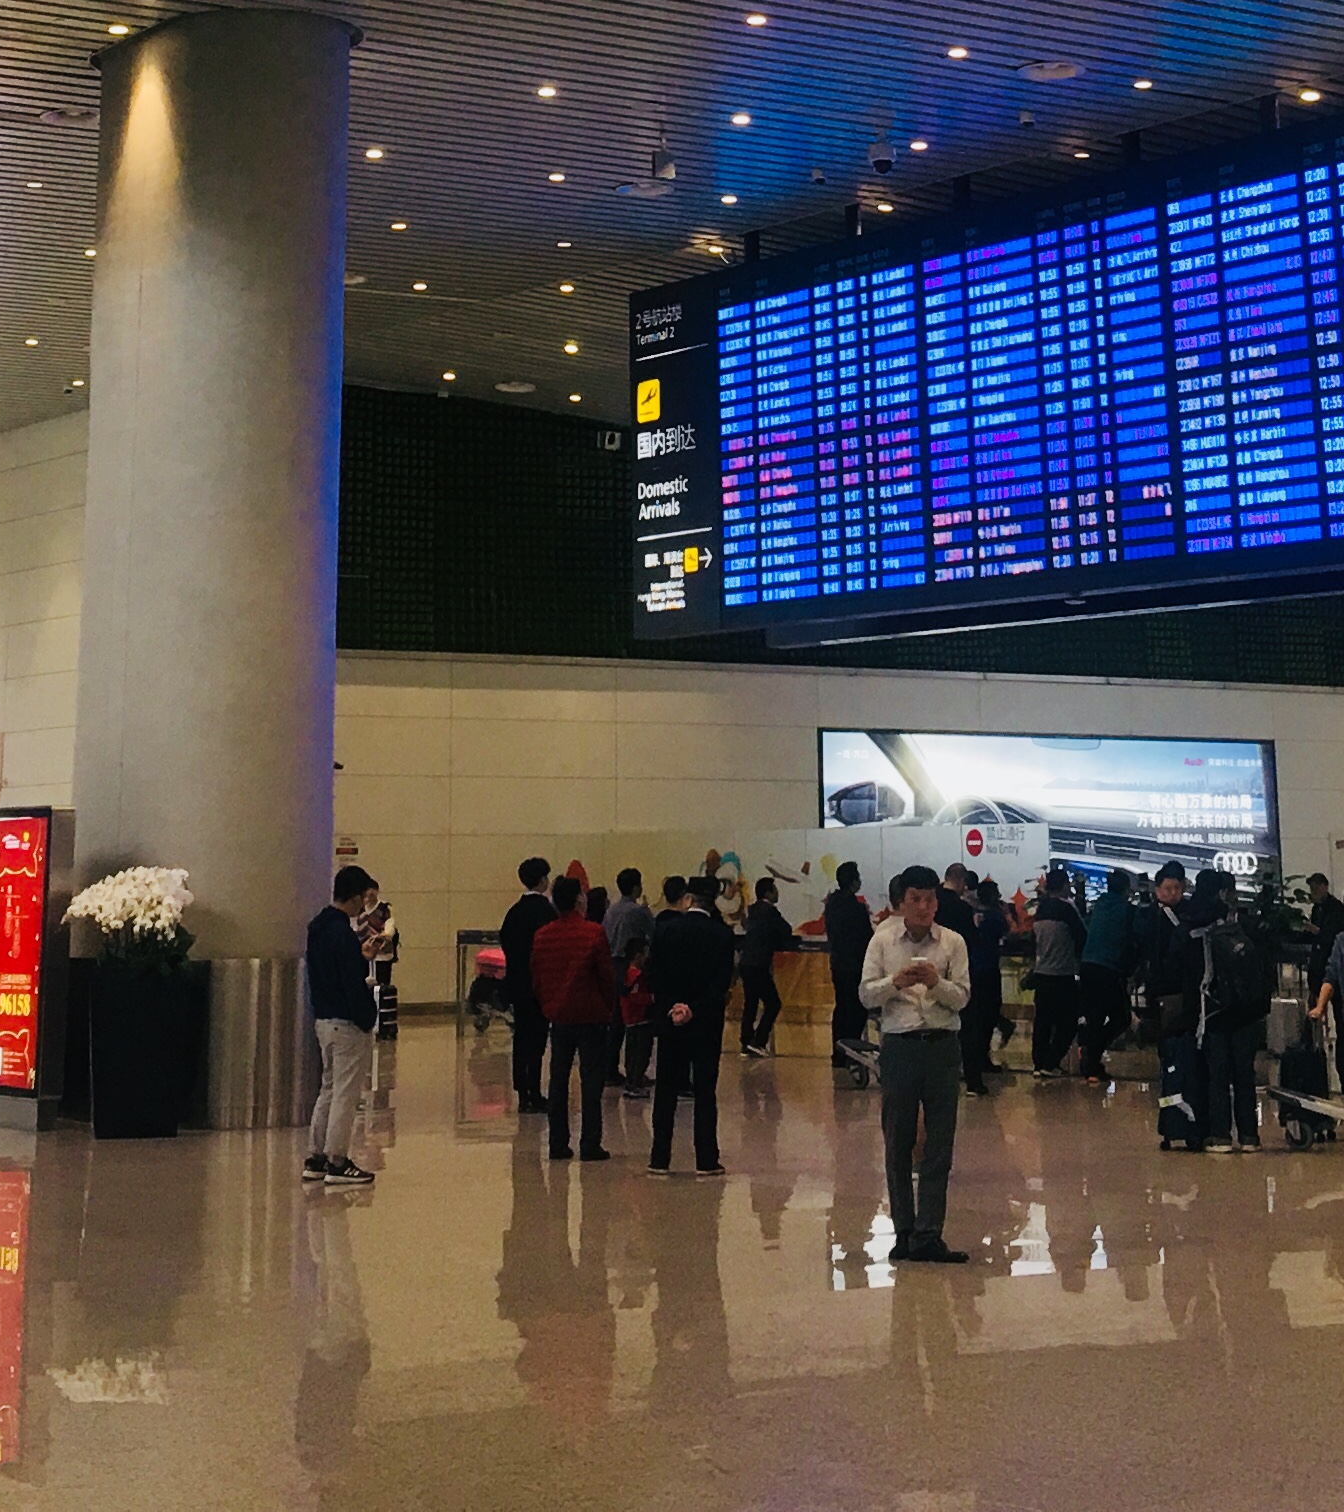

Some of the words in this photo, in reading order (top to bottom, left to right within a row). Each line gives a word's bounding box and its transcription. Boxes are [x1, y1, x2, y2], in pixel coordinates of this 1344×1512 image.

[636, 327, 669, 346] Terminal
[669, 326, 675, 339] 2
[1321, 395, 1342, 410] 12:55
[1322, 415, 1344, 430] 12:55
[637, 423, 697, 460] 国内到达
[637, 474, 688, 500] Domestic
[638, 497, 681, 521] Arrivals
[986, 844, 997, 854] No
[998, 843, 1020, 856] Entry
